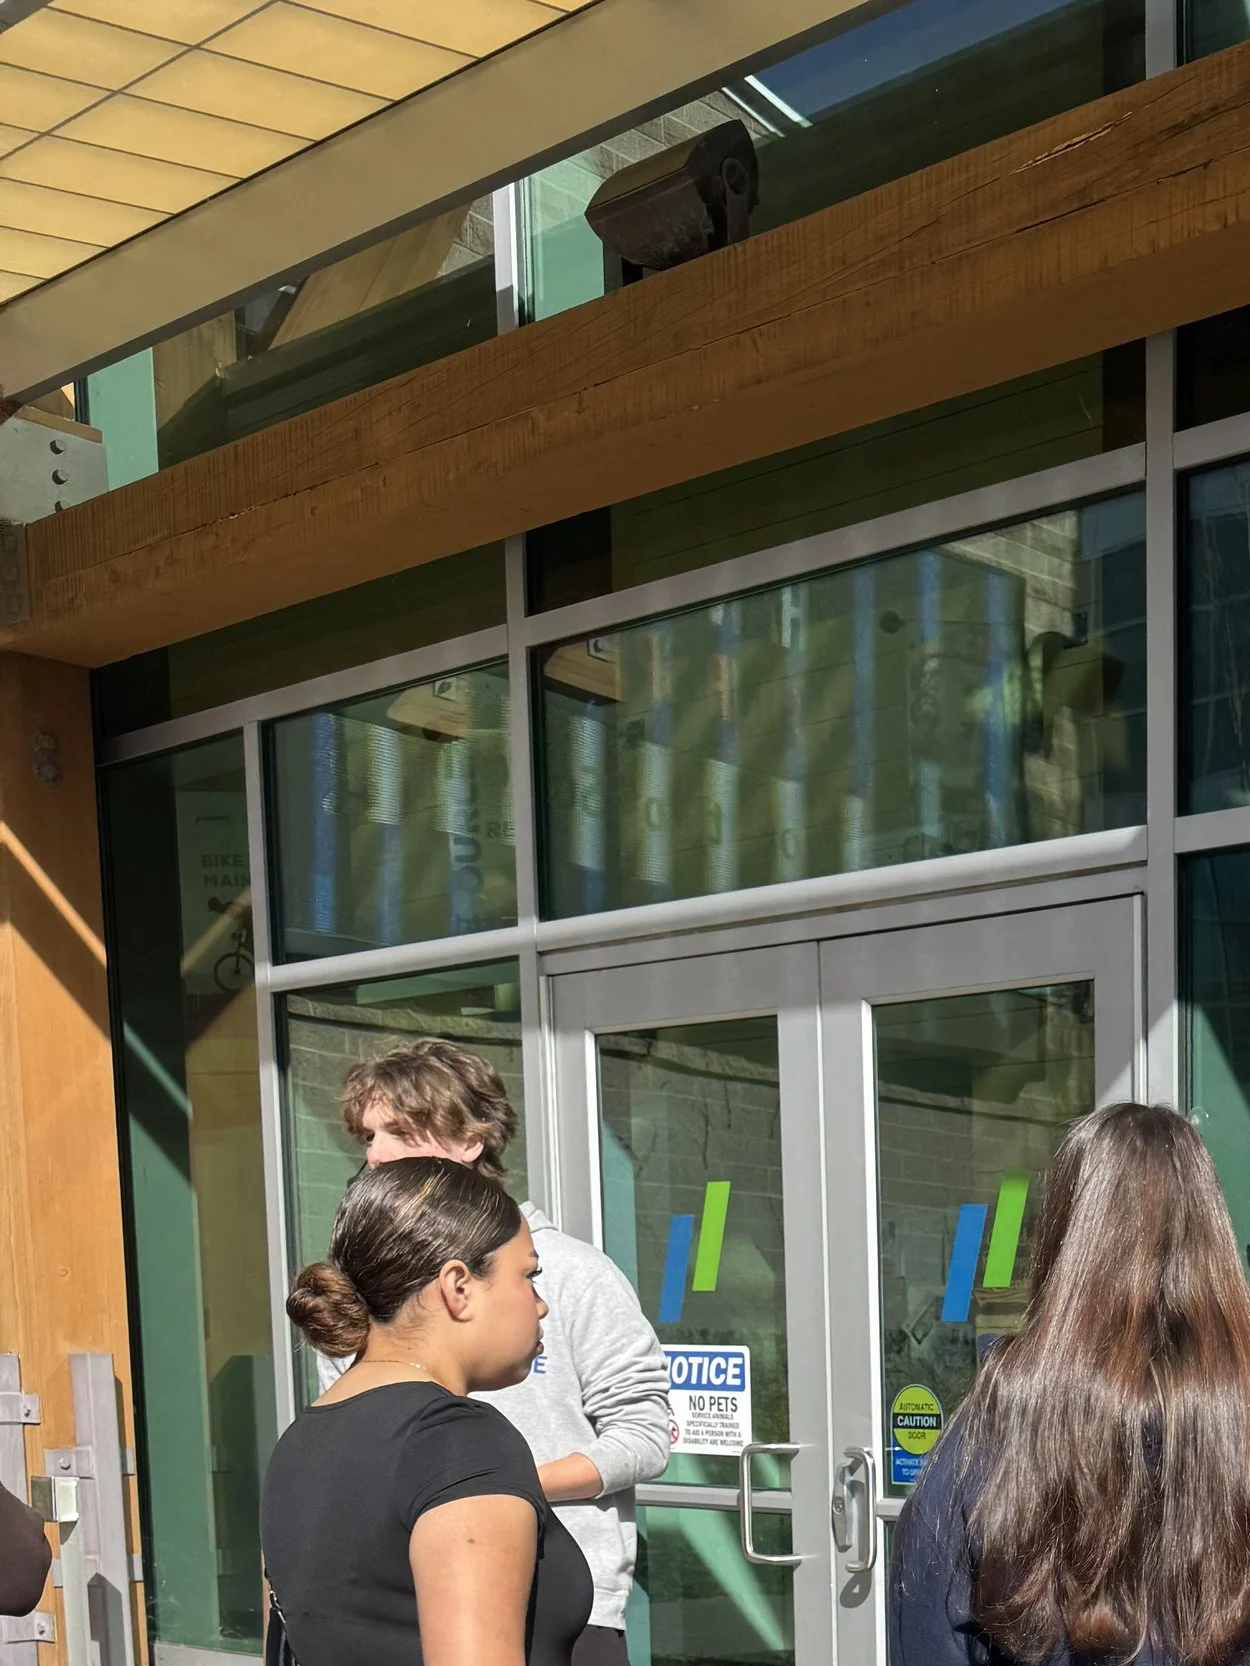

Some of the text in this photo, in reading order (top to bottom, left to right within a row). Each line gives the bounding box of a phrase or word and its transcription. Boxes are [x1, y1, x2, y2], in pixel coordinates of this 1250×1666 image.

[201, 854, 245, 868] BIKE
[689, 1395, 738, 1412] NO PETS
[899, 1403, 934, 1412] AUTOMATIC
[897, 1416, 936, 1427] CAUTION
[908, 1432, 926, 1440] DOOR
